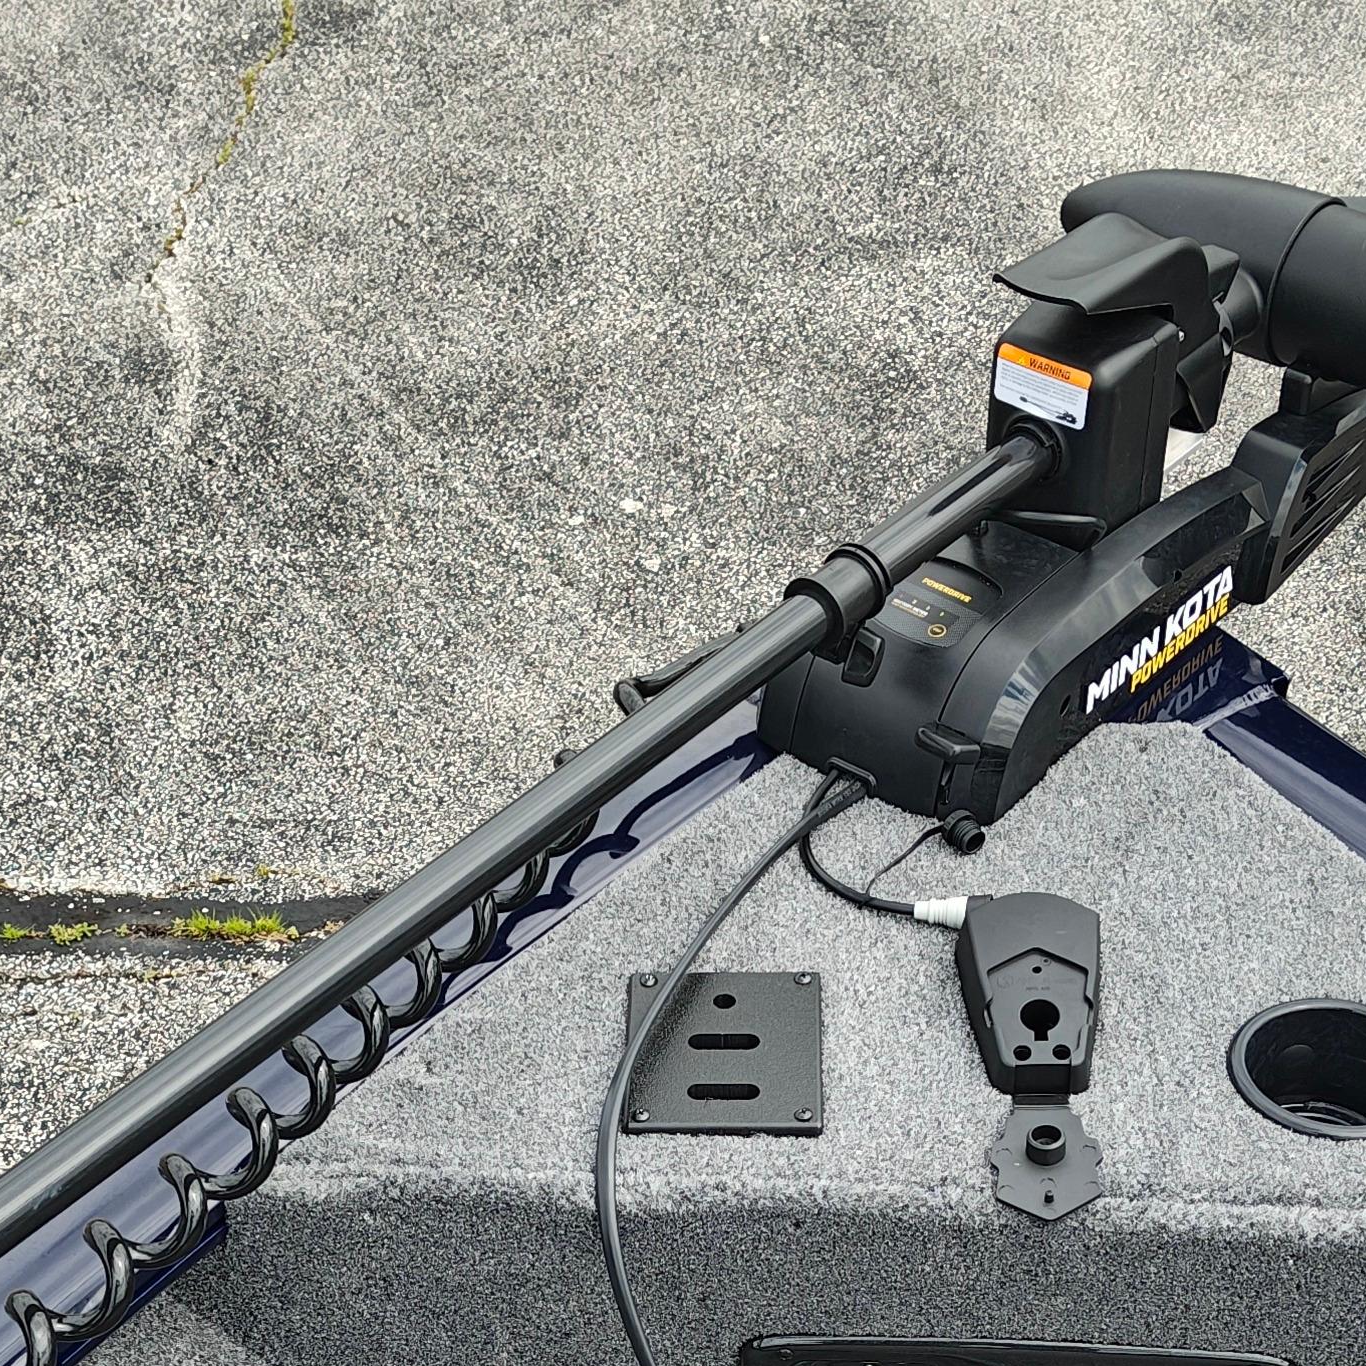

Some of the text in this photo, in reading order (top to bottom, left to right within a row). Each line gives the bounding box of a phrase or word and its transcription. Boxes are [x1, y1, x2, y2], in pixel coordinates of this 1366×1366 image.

[1029, 357, 1071, 380] WARNING
[921, 577, 972, 603] POWERDRIVE
[1086, 565, 1233, 715] MINN KOTA
[1130, 593, 1230, 693] POWERDRIVE
